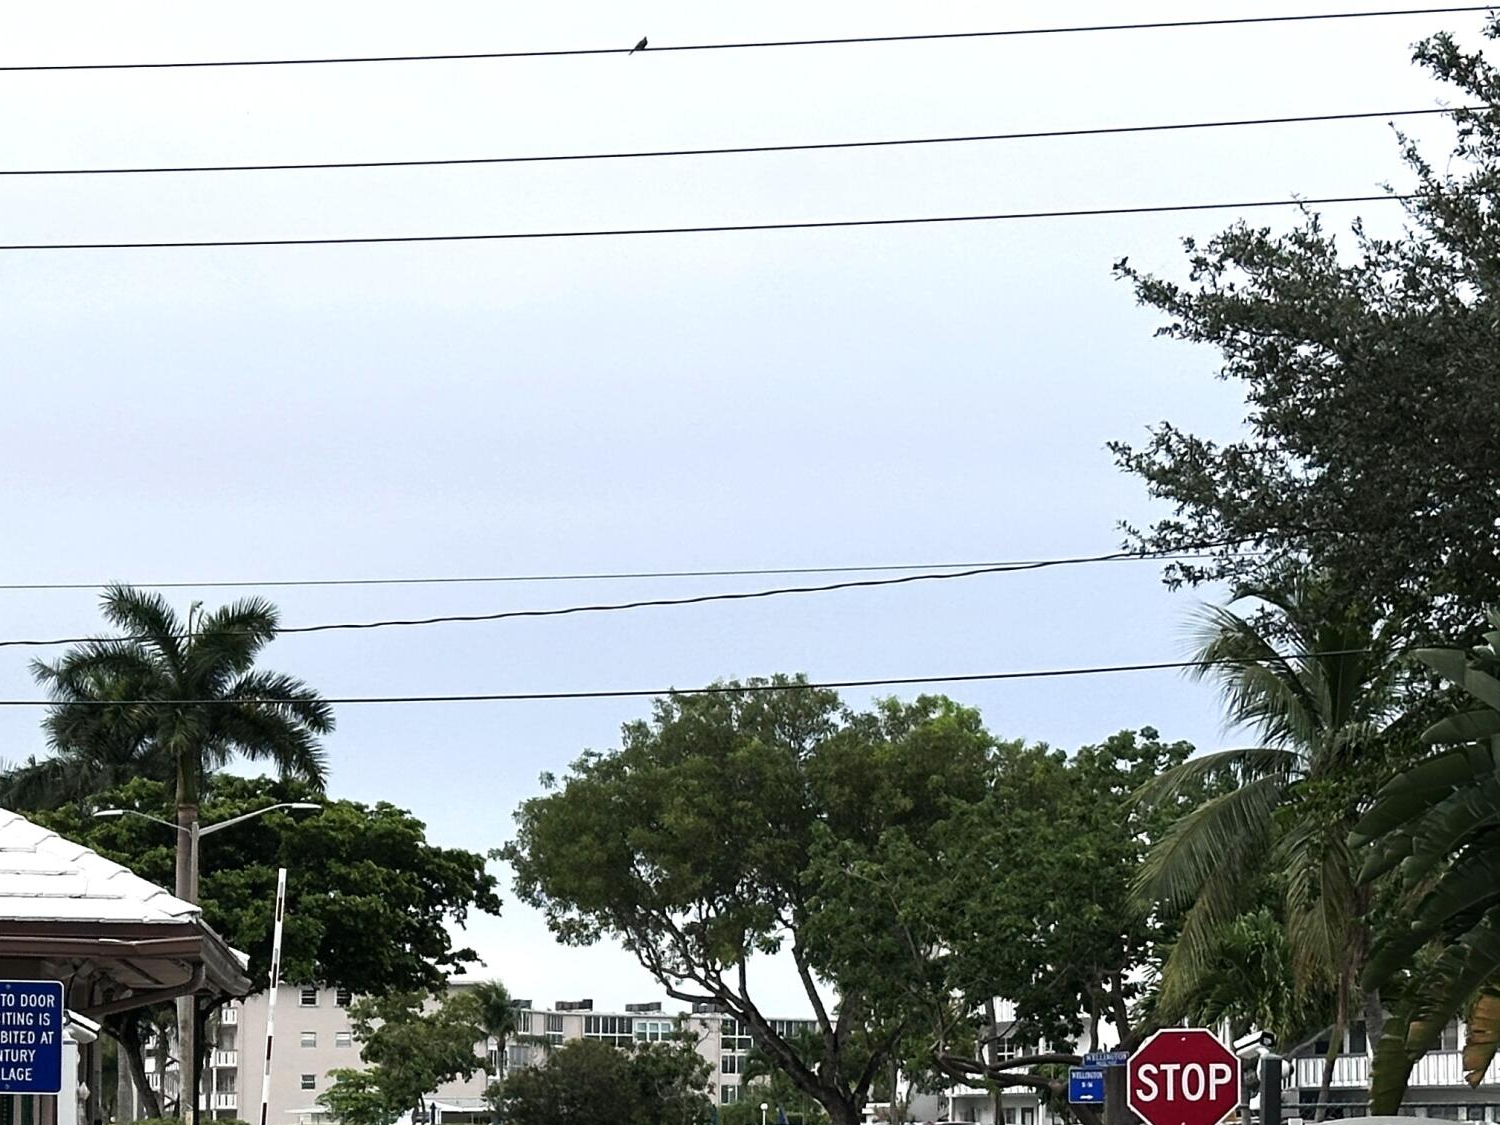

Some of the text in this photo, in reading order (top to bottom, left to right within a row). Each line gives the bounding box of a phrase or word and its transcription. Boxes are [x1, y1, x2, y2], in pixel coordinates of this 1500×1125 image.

[0, 993, 15, 1007] TO
[20, 994, 55, 1008] DOOR
[38, 1012, 51, 1026] IS
[40, 1031, 55, 1045] AT
[1136, 1063, 1232, 1102] STOP
